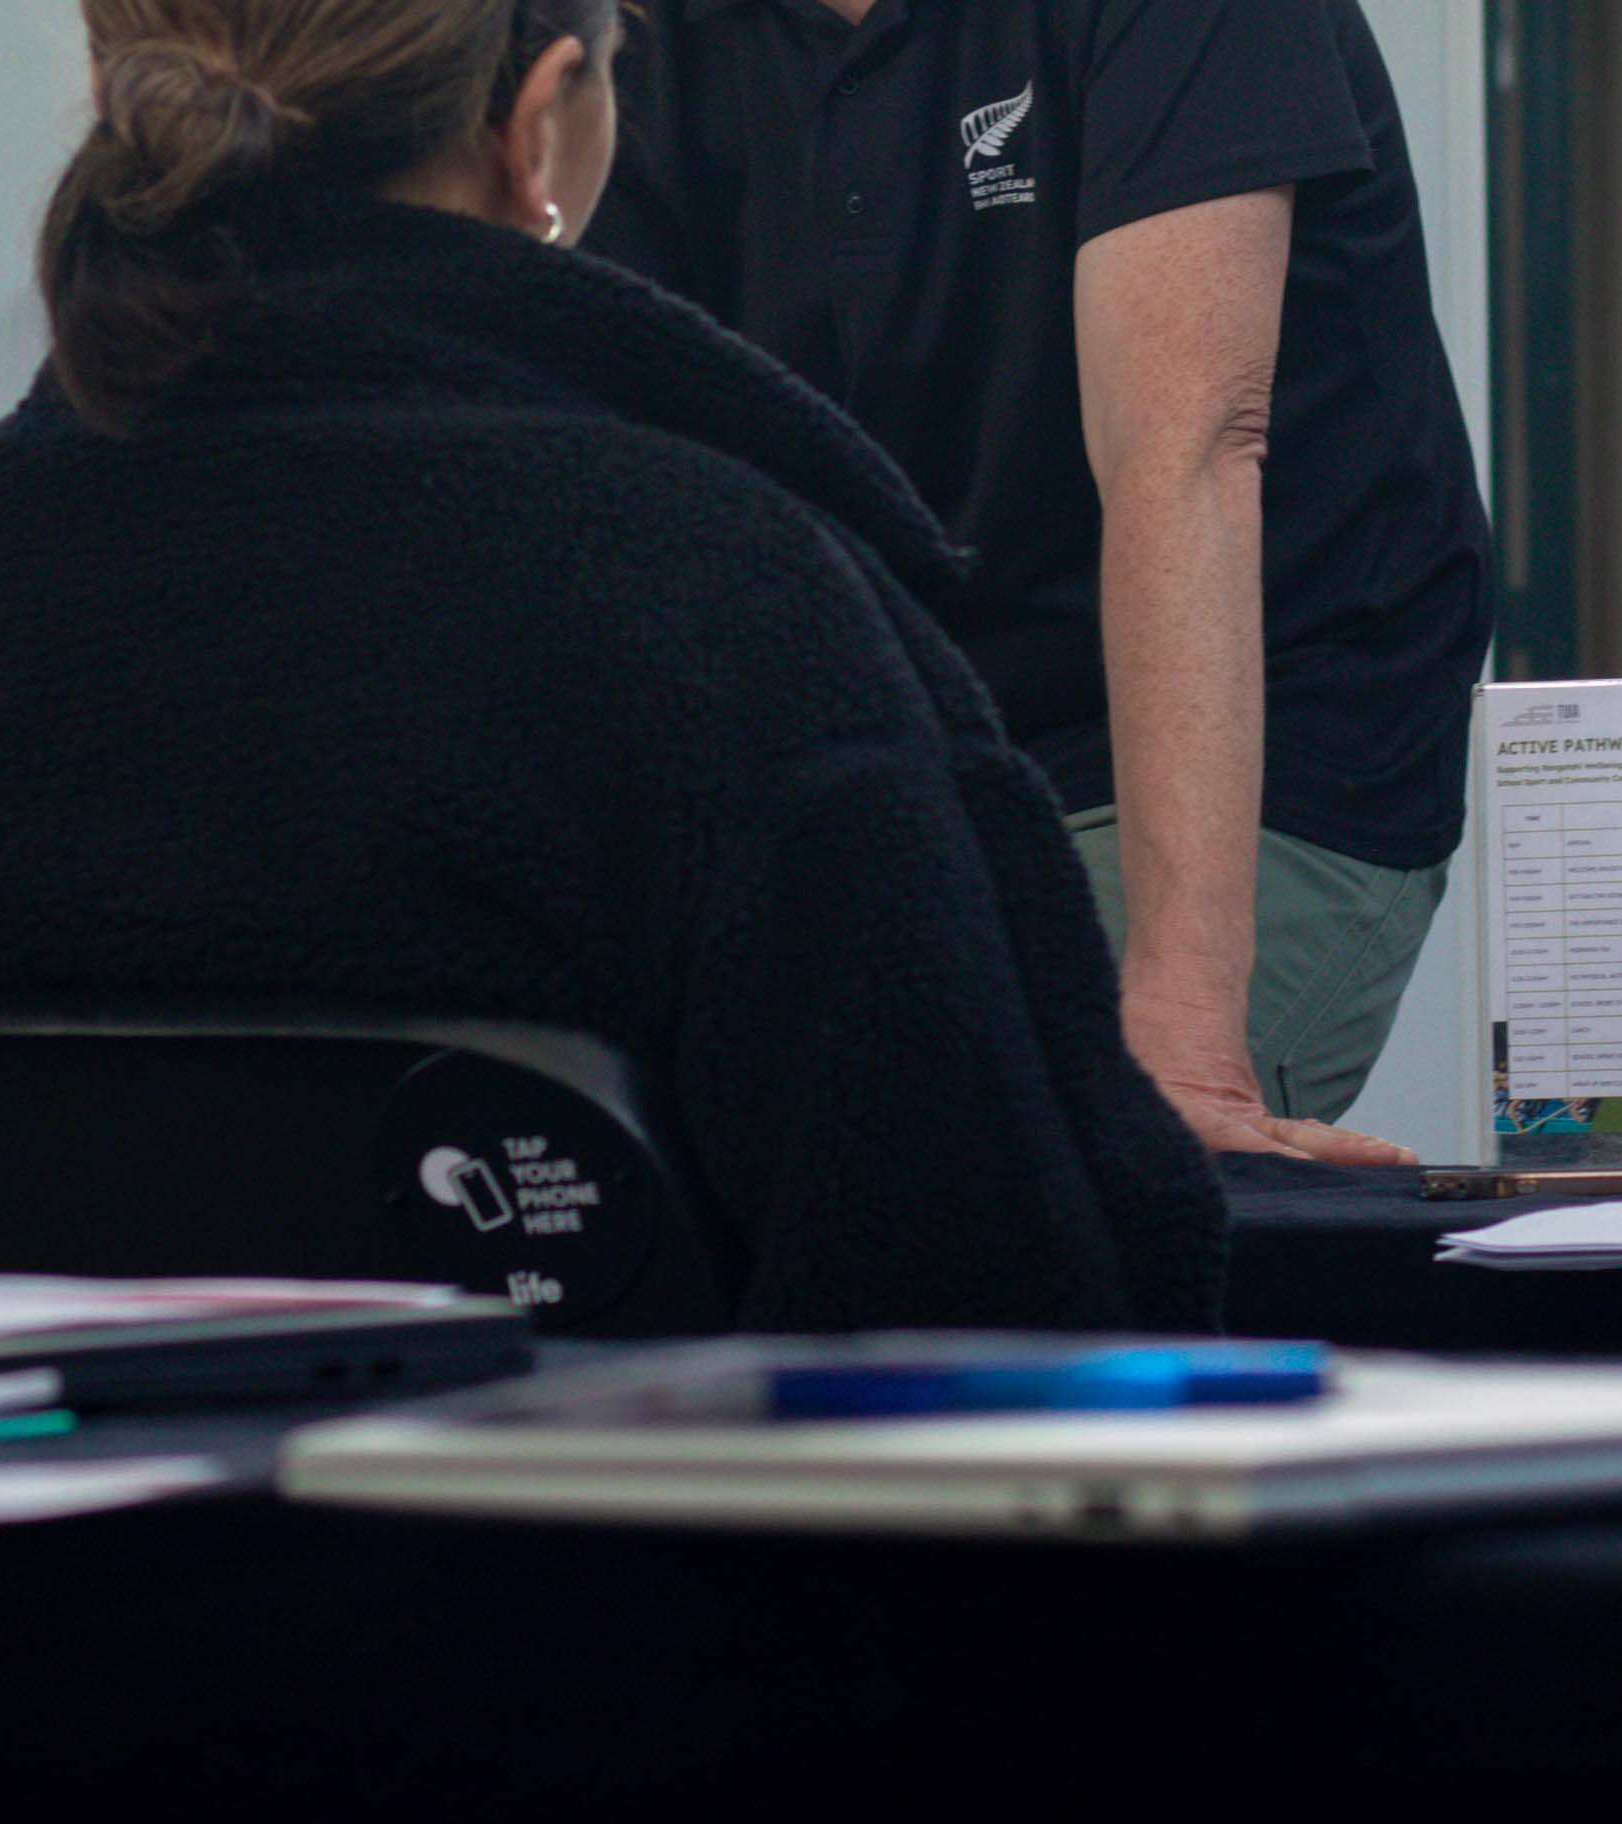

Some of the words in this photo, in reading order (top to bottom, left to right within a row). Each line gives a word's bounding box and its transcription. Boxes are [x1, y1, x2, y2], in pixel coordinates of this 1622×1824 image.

[968, 164, 1015, 185] SPORT
[1498, 740, 1558, 755] ACTIVE
[501, 1136, 548, 1161] TAP
[508, 1159, 577, 1185] YOUR
[517, 1182, 600, 1210] PHONE
[523, 1210, 583, 1236] HERE
[506, 1270, 563, 1306] life
